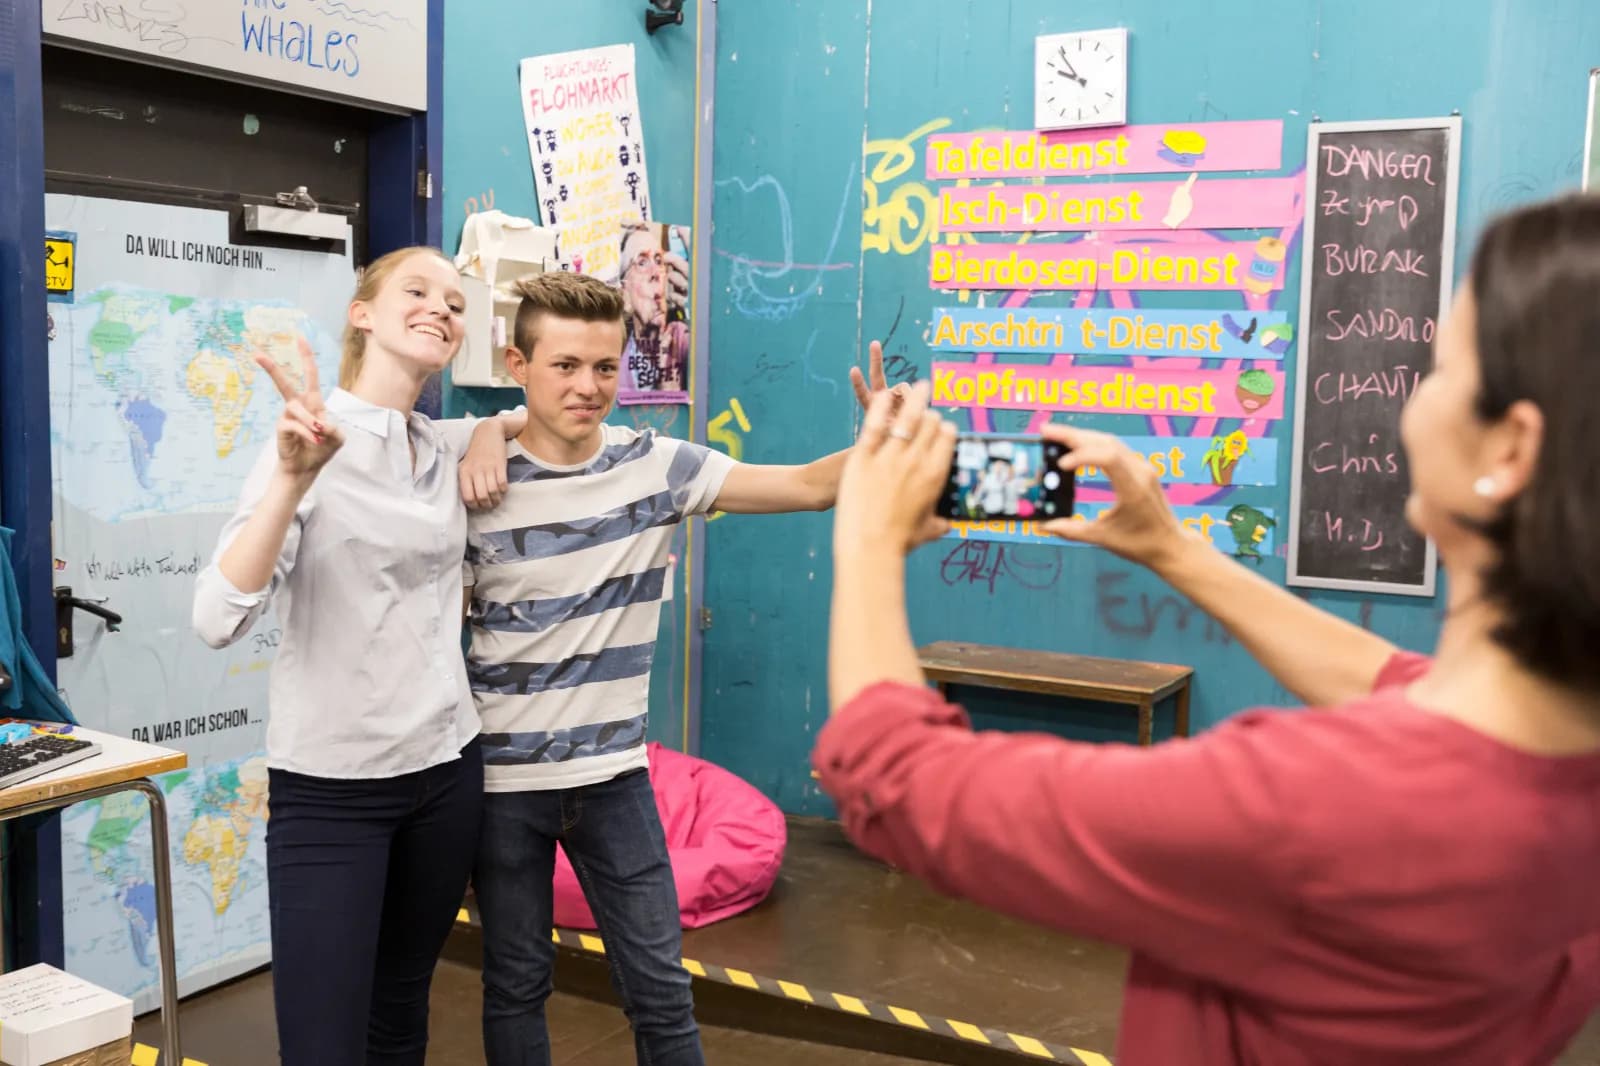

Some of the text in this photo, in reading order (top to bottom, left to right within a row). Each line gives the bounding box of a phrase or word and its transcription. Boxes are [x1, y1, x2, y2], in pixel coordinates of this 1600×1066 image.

[529, 72, 630, 118] FLOHMARKT
[931, 134, 1131, 175] Tafeldienst
[942, 190, 1145, 226] Isch-Dienst
[126, 234, 144, 255] DA
[148, 236, 179, 260] WILL
[182, 241, 203, 262] ICH
[206, 244, 239, 267] NOCH
[242, 249, 263, 270] HIN
[932, 246, 1241, 286] Bierdosen-Dienst
[153, 720, 182, 743] WAR
[185, 716, 206, 737] ICH
[208, 708, 248, 732] SCHON
